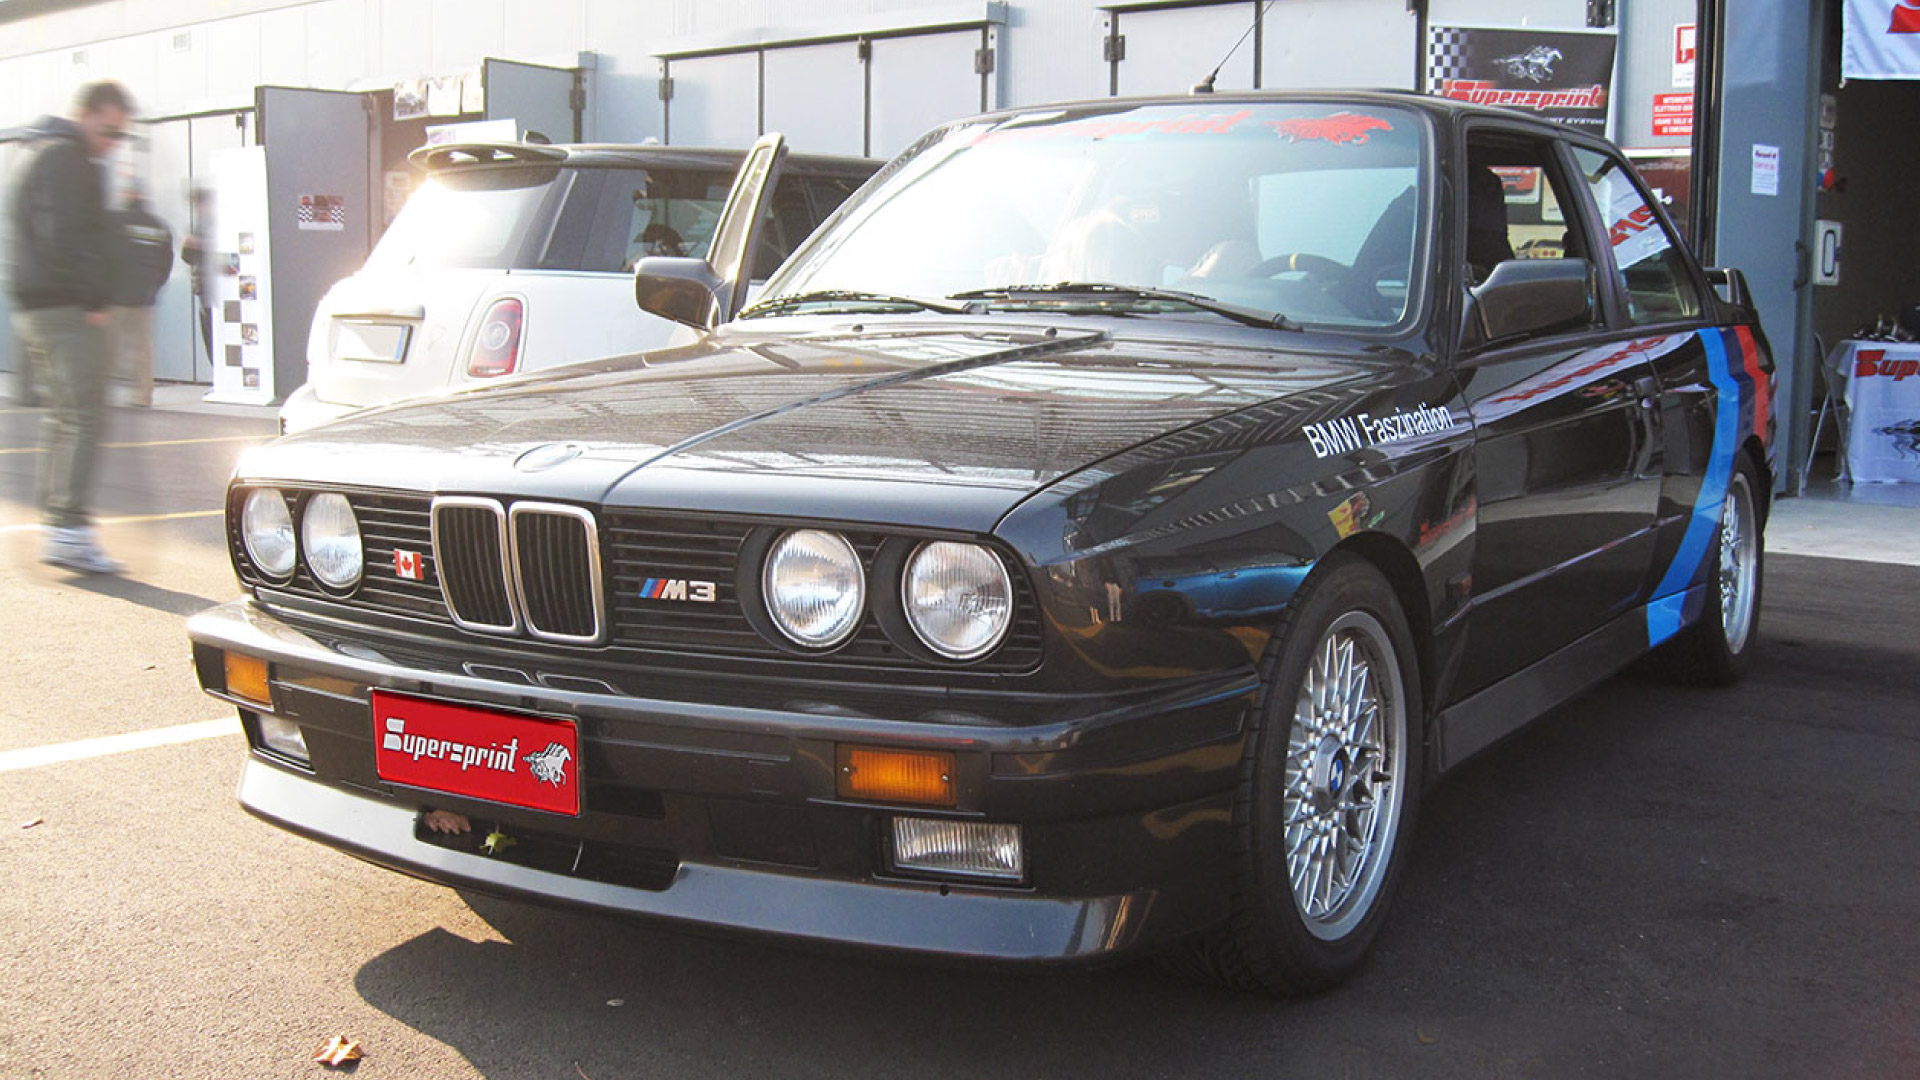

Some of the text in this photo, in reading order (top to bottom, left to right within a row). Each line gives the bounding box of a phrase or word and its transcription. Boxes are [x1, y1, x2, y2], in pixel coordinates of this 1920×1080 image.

[1449, 79, 1603, 111] Supersprint
[1855, 350, 1920, 381] Sup
[1302, 402, 1455, 458] BMW Faszination
[660, 579, 716, 602] M3
[383, 717, 518, 773] Supersprint
